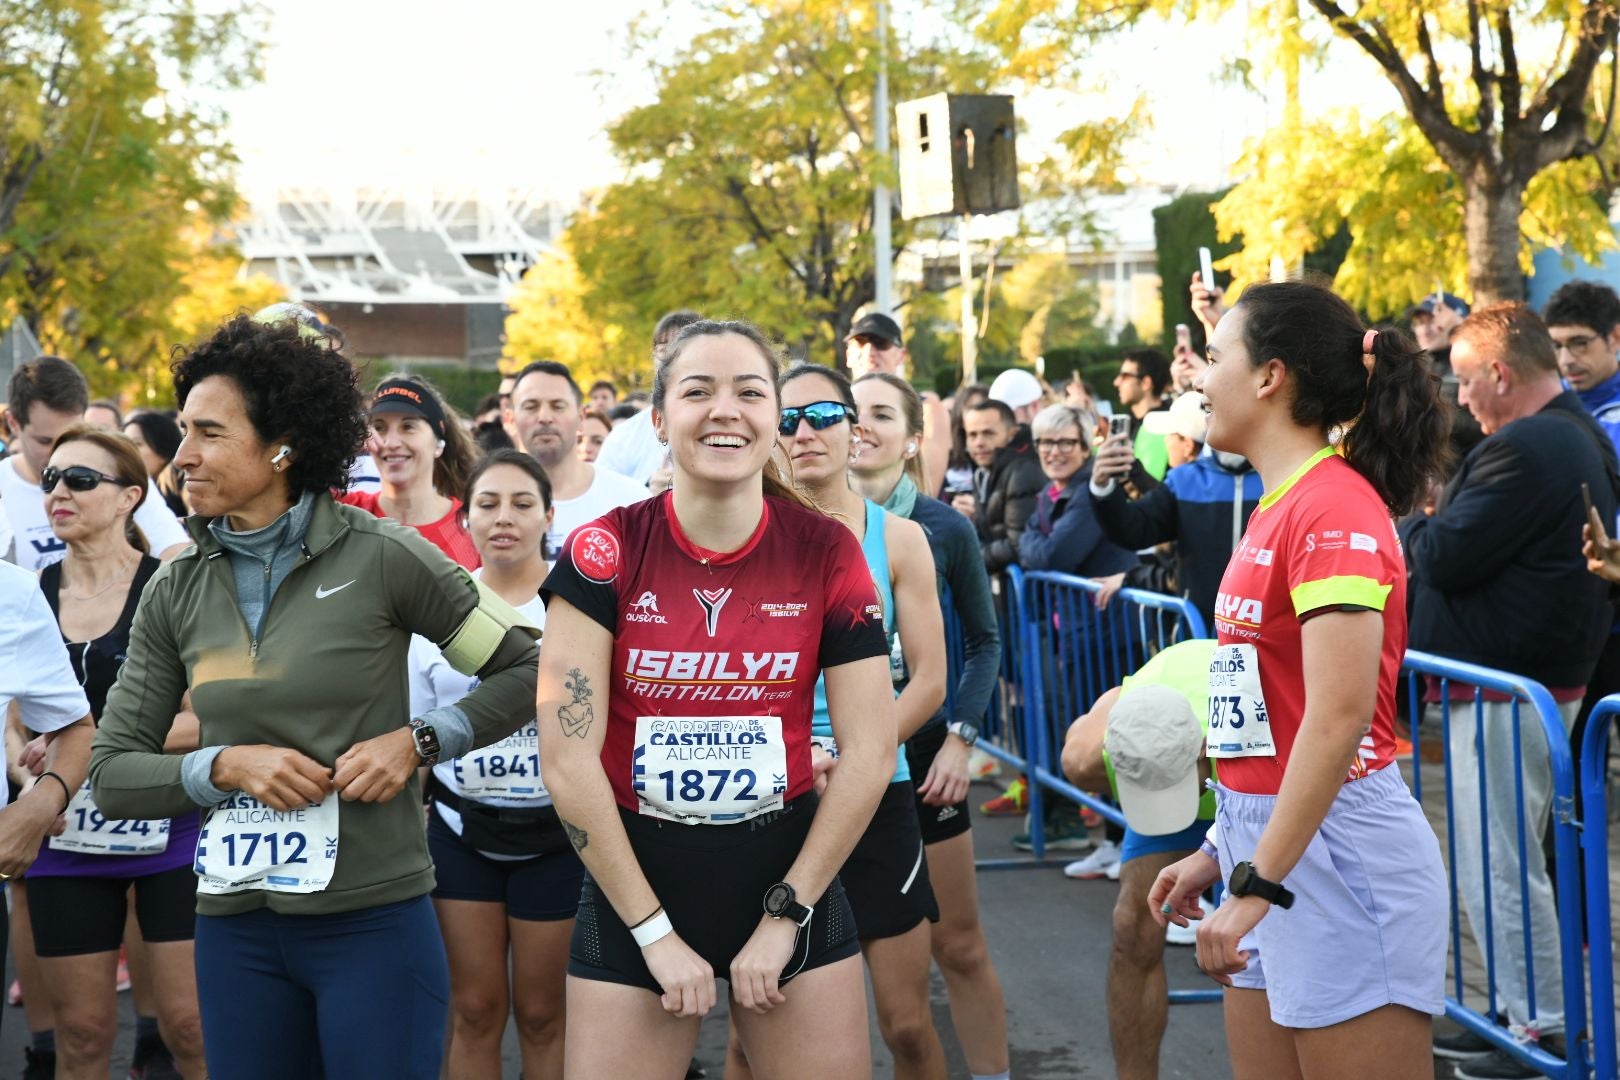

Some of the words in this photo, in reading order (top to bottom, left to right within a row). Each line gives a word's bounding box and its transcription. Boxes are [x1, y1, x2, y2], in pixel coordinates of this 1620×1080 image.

[625, 648, 800, 680] ISBILYA
[625, 678, 767, 701] TRIATHLON
[764, 690, 793, 700] TEAM
[1253, 700, 1268, 723] 5K
[650, 720, 748, 732] CARRERA
[650, 731, 768, 746] CASTILLOS
[666, 746, 752, 760] ALICANTE
[474, 753, 539, 778] 1841
[658, 768, 759, 802] 1872
[772, 773, 786, 794] 5K
[75, 807, 151, 837] 1924
[225, 810, 306, 824] ALICANTE
[222, 831, 308, 866] 1712
[325, 835, 338, 860] 5K
